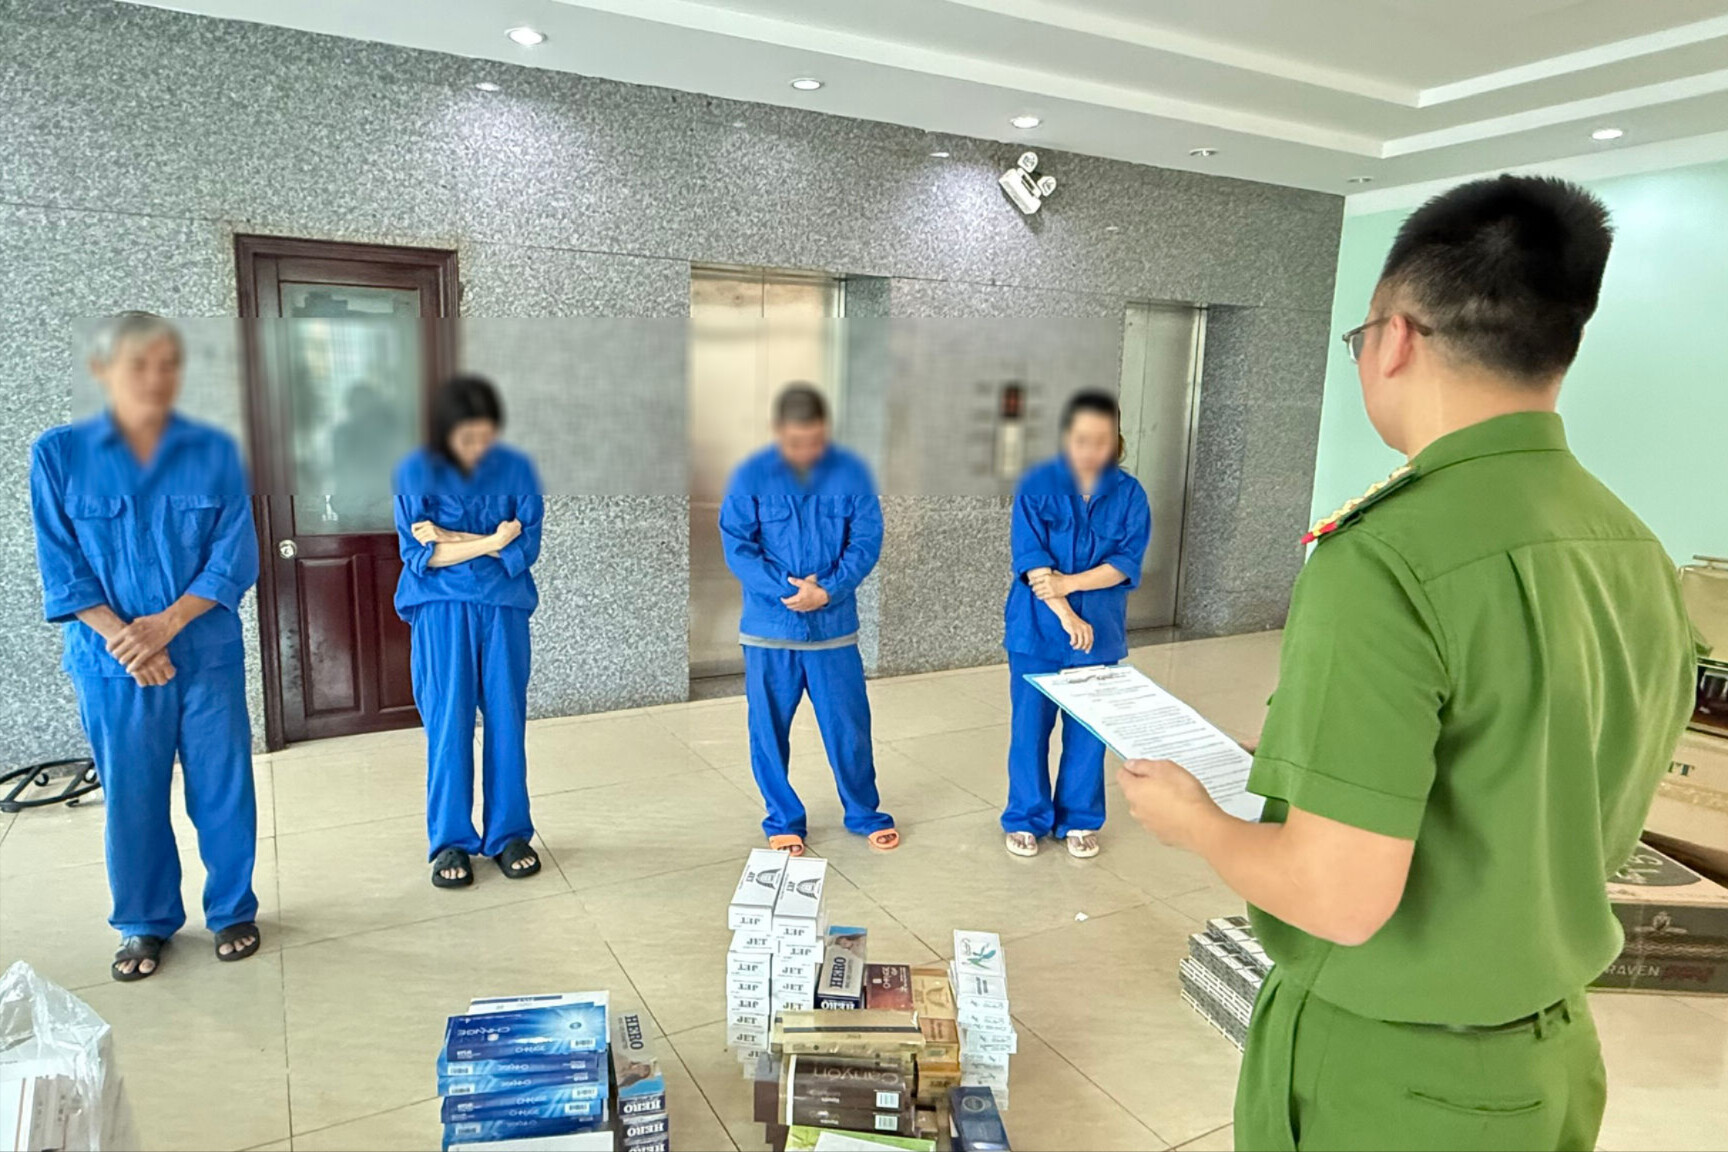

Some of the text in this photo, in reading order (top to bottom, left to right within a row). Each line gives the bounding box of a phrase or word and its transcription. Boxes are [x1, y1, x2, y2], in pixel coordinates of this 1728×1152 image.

[740, 916, 760, 925] JET
[784, 928, 804, 936] JET
[782, 966, 803, 975] JET
[830, 957, 846, 988] HERO
[1605, 964, 1660, 976] RAVEN
[738, 983, 758, 991] JET
[783, 983, 804, 991] JET
[738, 1000, 758, 1008] JET
[783, 1002, 803, 1010] JET
[737, 1016, 757, 1024] JET
[625, 1014, 644, 1050] HERO
[623, 1100, 661, 1113] HERO
[627, 1122, 665, 1137] HERO
